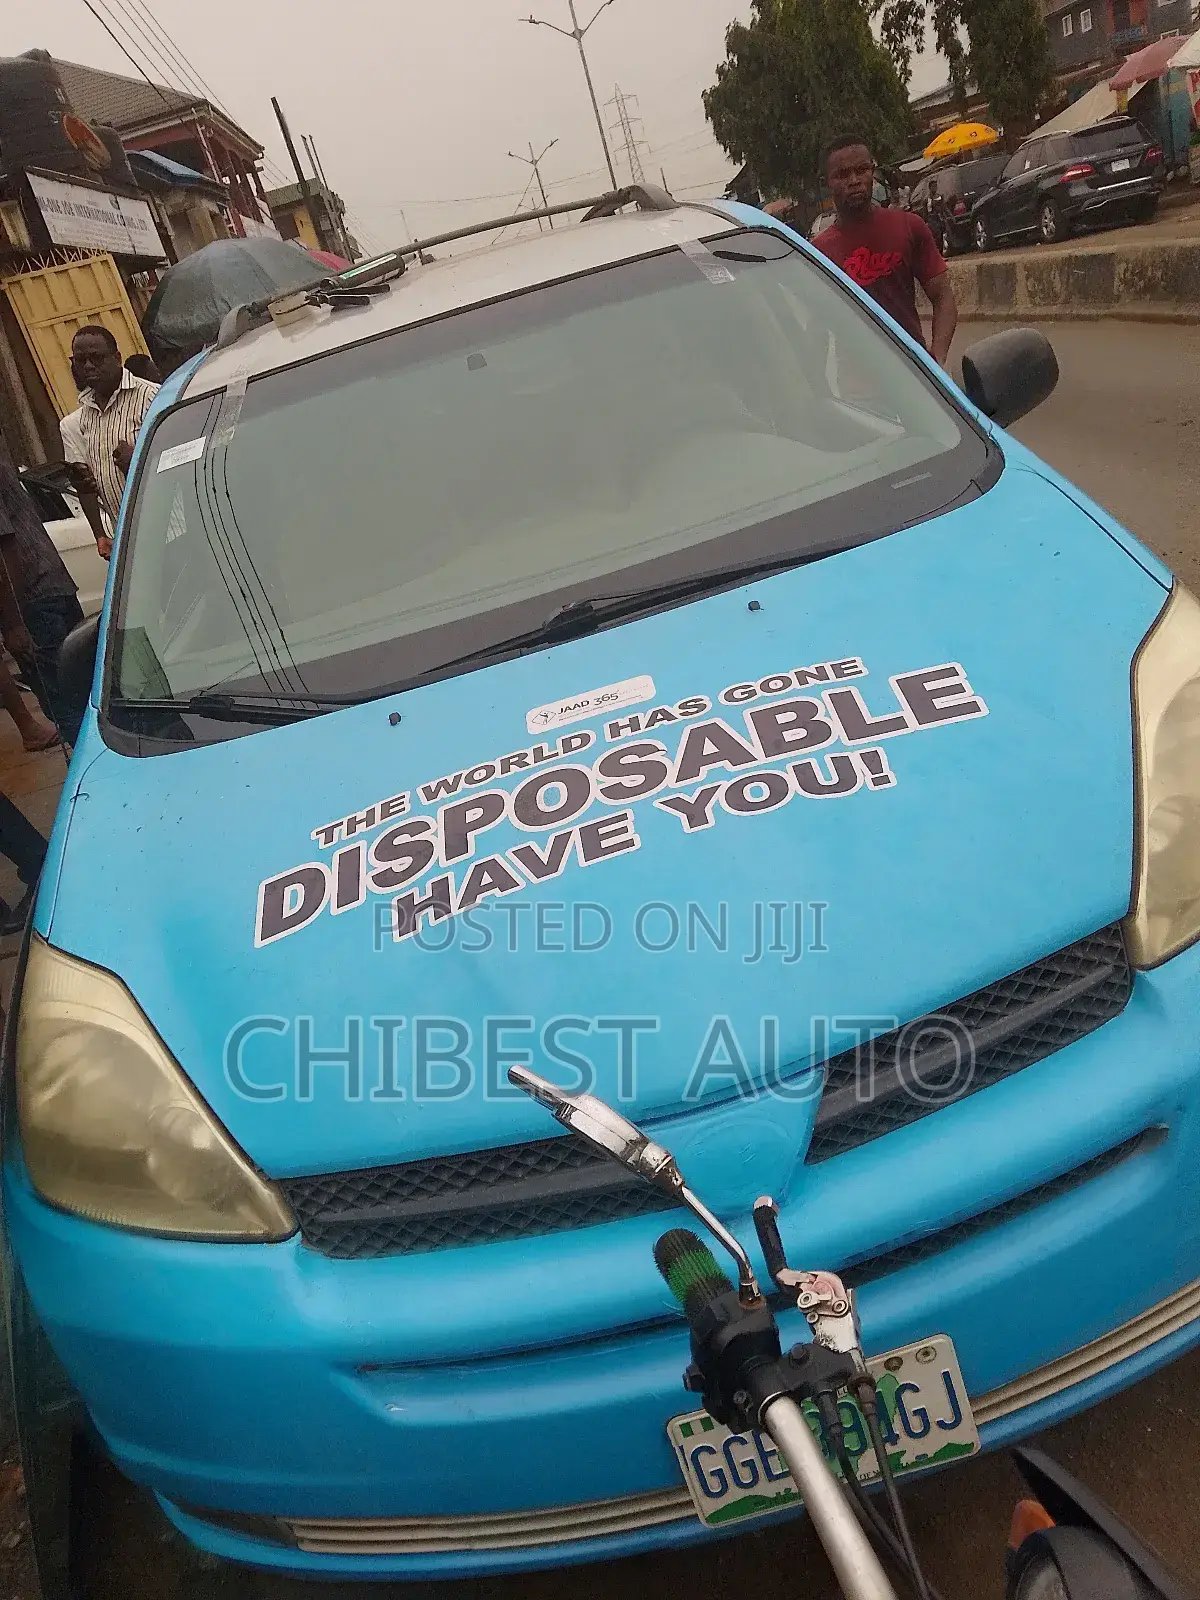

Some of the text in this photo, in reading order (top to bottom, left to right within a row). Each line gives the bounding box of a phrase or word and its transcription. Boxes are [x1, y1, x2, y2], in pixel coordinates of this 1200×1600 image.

[315, 794, 406, 846] THE
[421, 730, 592, 802] WORLD
[607, 697, 709, 739] HAS
[722, 658, 864, 704] GONE
[558, 700, 590, 715] JAAD
[594, 692, 619, 706] 365
[258, 664, 985, 944] DISPOSABLE
[396, 749, 892, 939] HAVE YOU!
